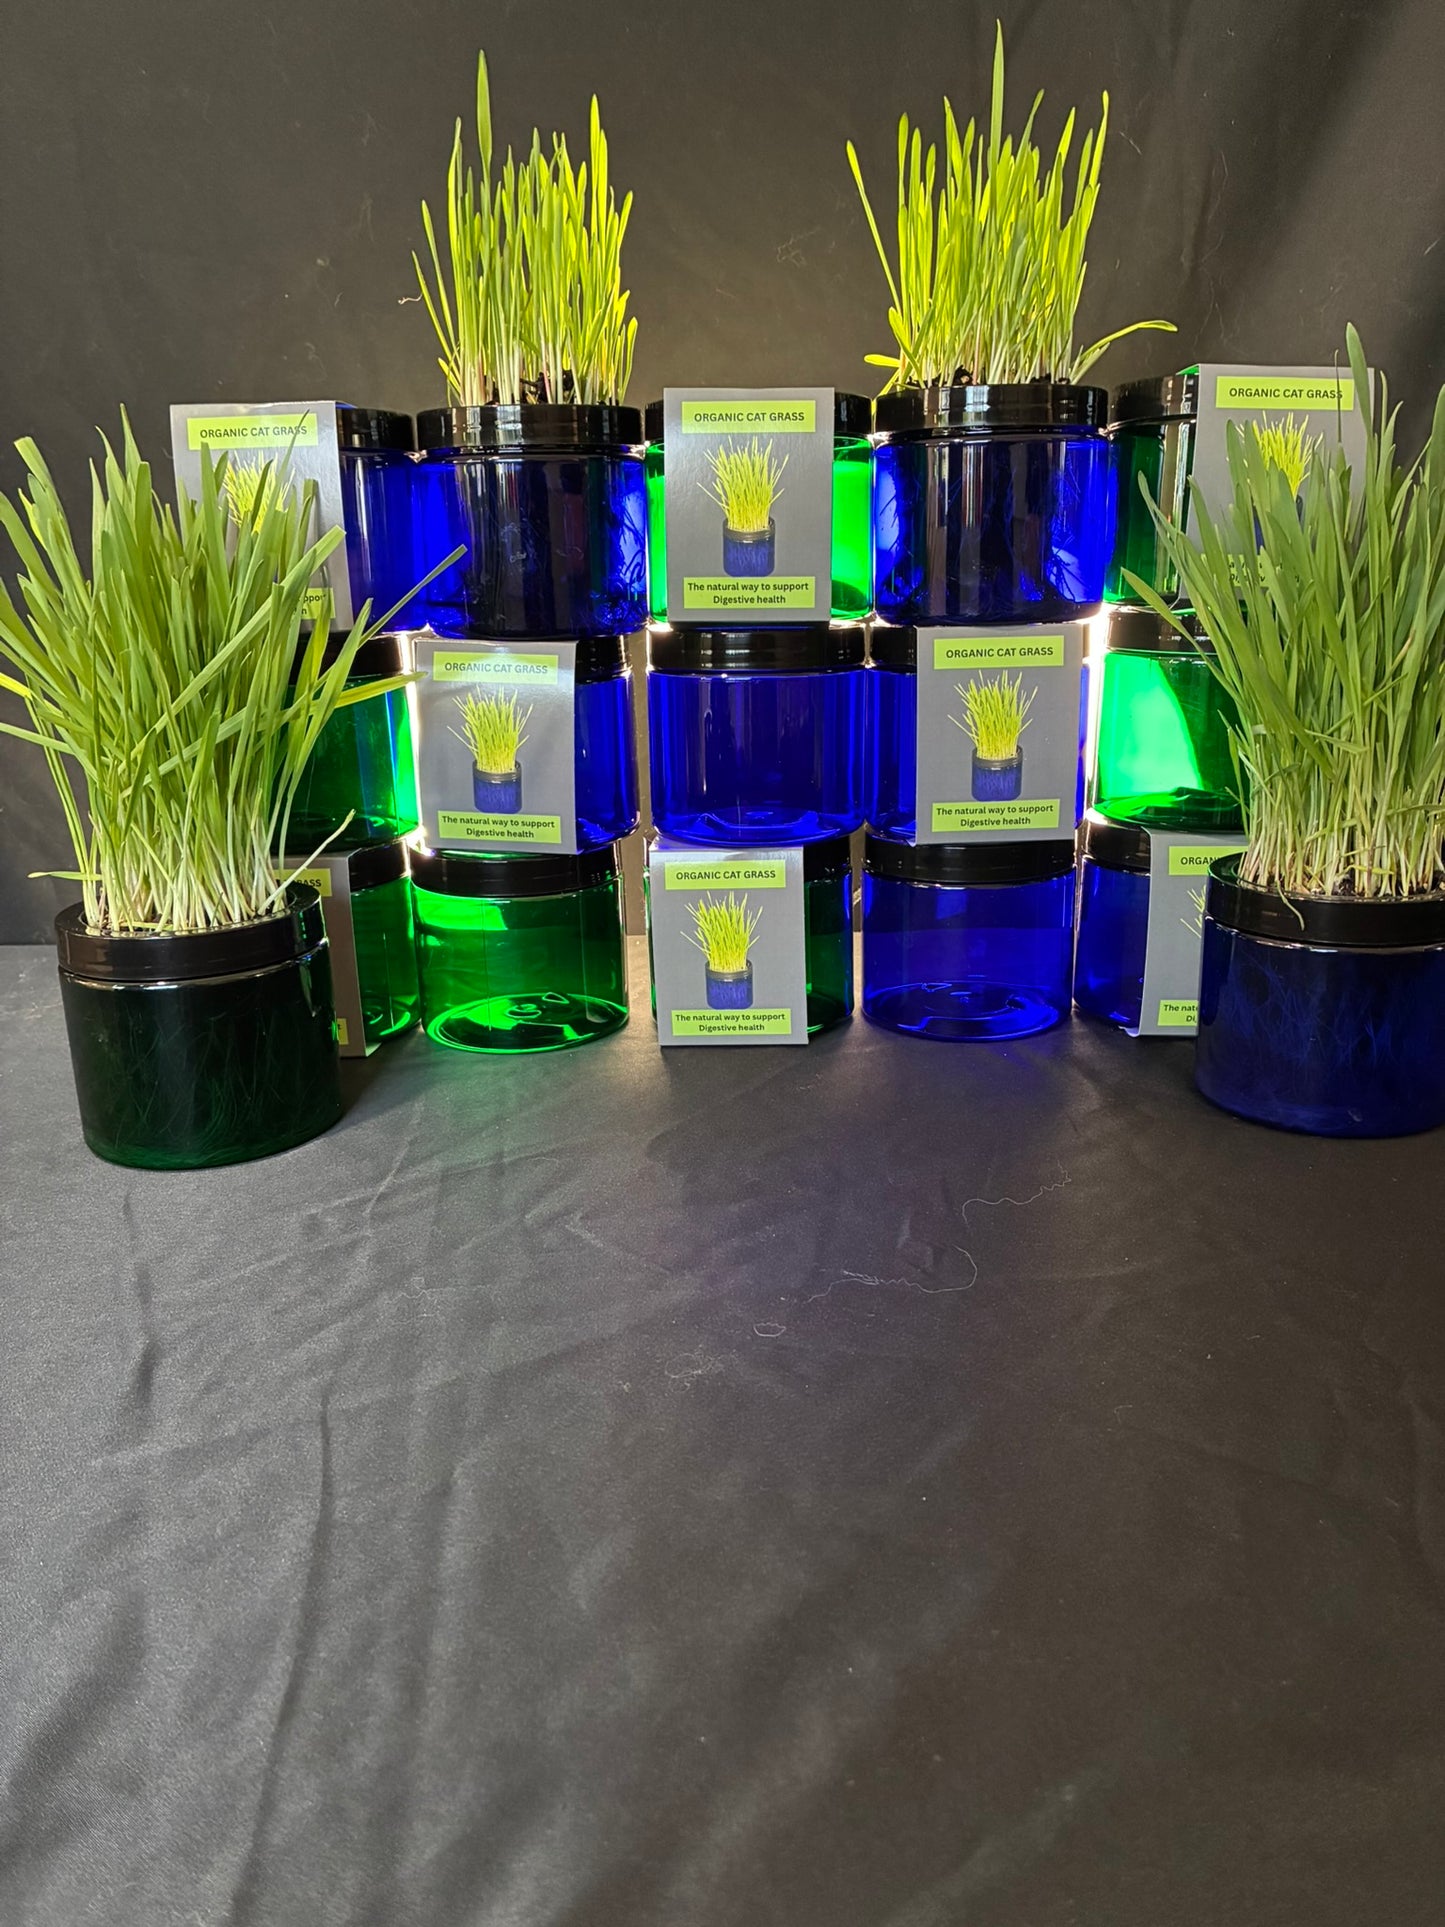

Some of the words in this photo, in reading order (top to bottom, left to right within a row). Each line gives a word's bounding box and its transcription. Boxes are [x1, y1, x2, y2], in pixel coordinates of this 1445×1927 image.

[1229, 388, 1280, 398] ORGANIC
[1283, 388, 1304, 398] CAT
[1306, 389, 1343, 399] GRASS
[694, 412, 744, 423] ORGANIC
[746, 412, 767, 422] CAT
[769, 412, 805, 422] GRASS
[200, 428, 248, 439] ORGANIC
[250, 427, 270, 437] CAT
[272, 425, 308, 436] GRASS
[688, 582, 705, 591] The
[706, 582, 740, 591] natural
[741, 584, 759, 593] way
[761, 582, 771, 591] to
[773, 583, 809, 593] support
[713, 595, 755, 605] Digestive
[756, 595, 786, 604] health
[945, 648, 995, 659] ORGANIC
[997, 647, 1017, 658] CAT
[1019, 646, 1054, 657] GRASS
[444, 662, 491, 673] ORGANIC
[493, 664, 512, 673] CAT
[515, 664, 548, 675] GRASS
[936, 807, 953, 816] The
[954, 806, 987, 815] natural
[988, 807, 1005, 816] way
[1007, 805, 1017, 814] to
[1019, 804, 1054, 815] support
[442, 815, 458, 824] The
[459, 817, 490, 826] natural
[491, 819, 509, 829] way
[510, 819, 519, 827] to
[521, 820, 555, 830] support
[960, 818, 1001, 828] Digestive
[1002, 816, 1031, 826] health
[466, 827, 505, 838] Digestive
[506, 829, 534, 838] health
[676, 871, 721, 881] ORGANIC
[723, 870, 741, 880] CAT
[743, 870, 776, 879] GRASS
[1163, 1004, 1180, 1012] The
[675, 1014, 691, 1022] The
[692, 1013, 722, 1022] natural
[723, 1015, 740, 1023] way
[742, 1013, 751, 1021] to
[752, 1013, 785, 1022] support
[698, 1024, 737, 1033] Digestive
[738, 1023, 765, 1032] health
